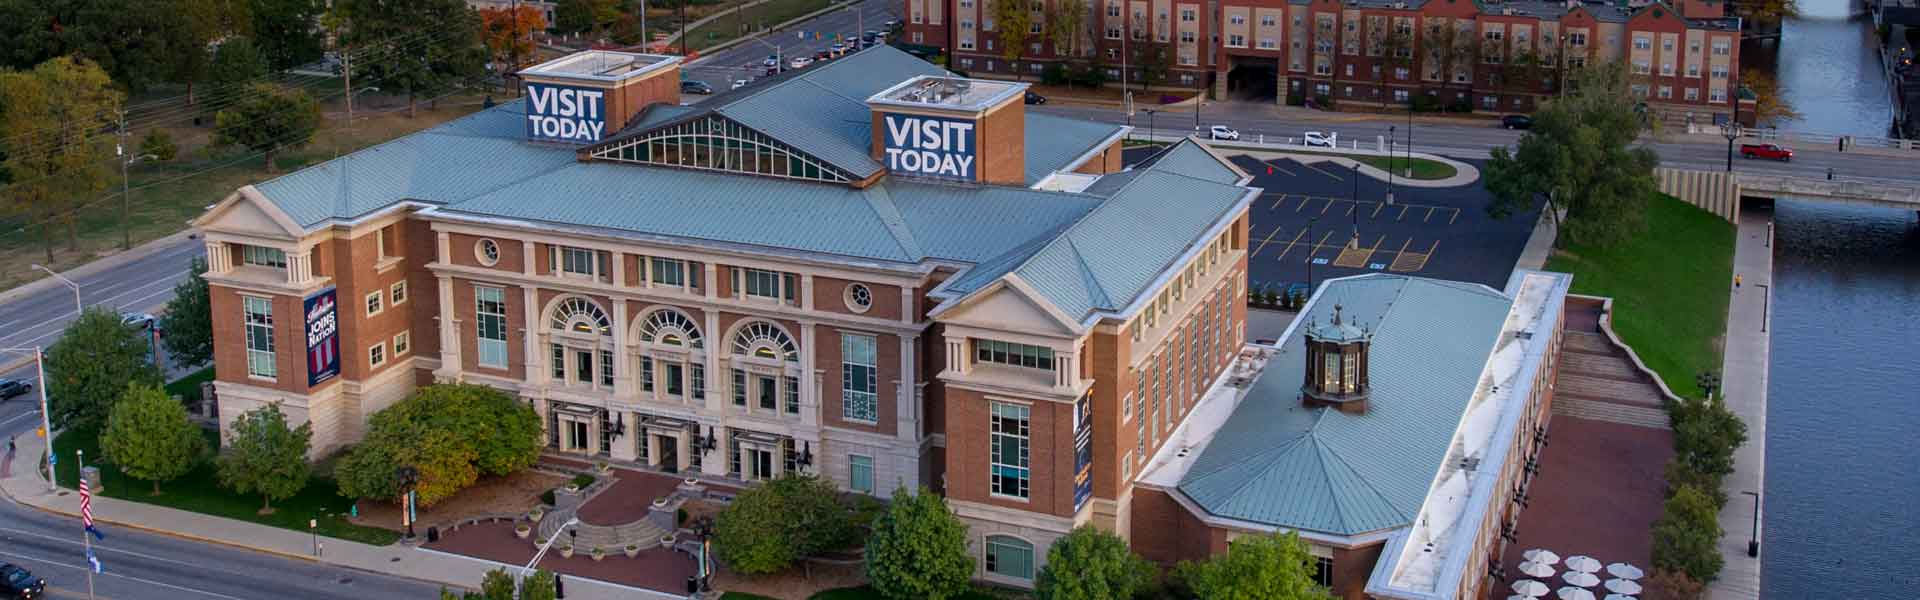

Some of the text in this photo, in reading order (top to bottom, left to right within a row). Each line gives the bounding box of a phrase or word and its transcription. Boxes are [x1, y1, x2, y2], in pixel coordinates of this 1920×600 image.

[528, 85, 603, 119] VISIT
[528, 115, 604, 141] TODAY
[886, 116, 973, 152] VISIT
[886, 147, 973, 177] TODAY
[308, 312, 335, 336] JOINS
[308, 320, 336, 348] NATION
